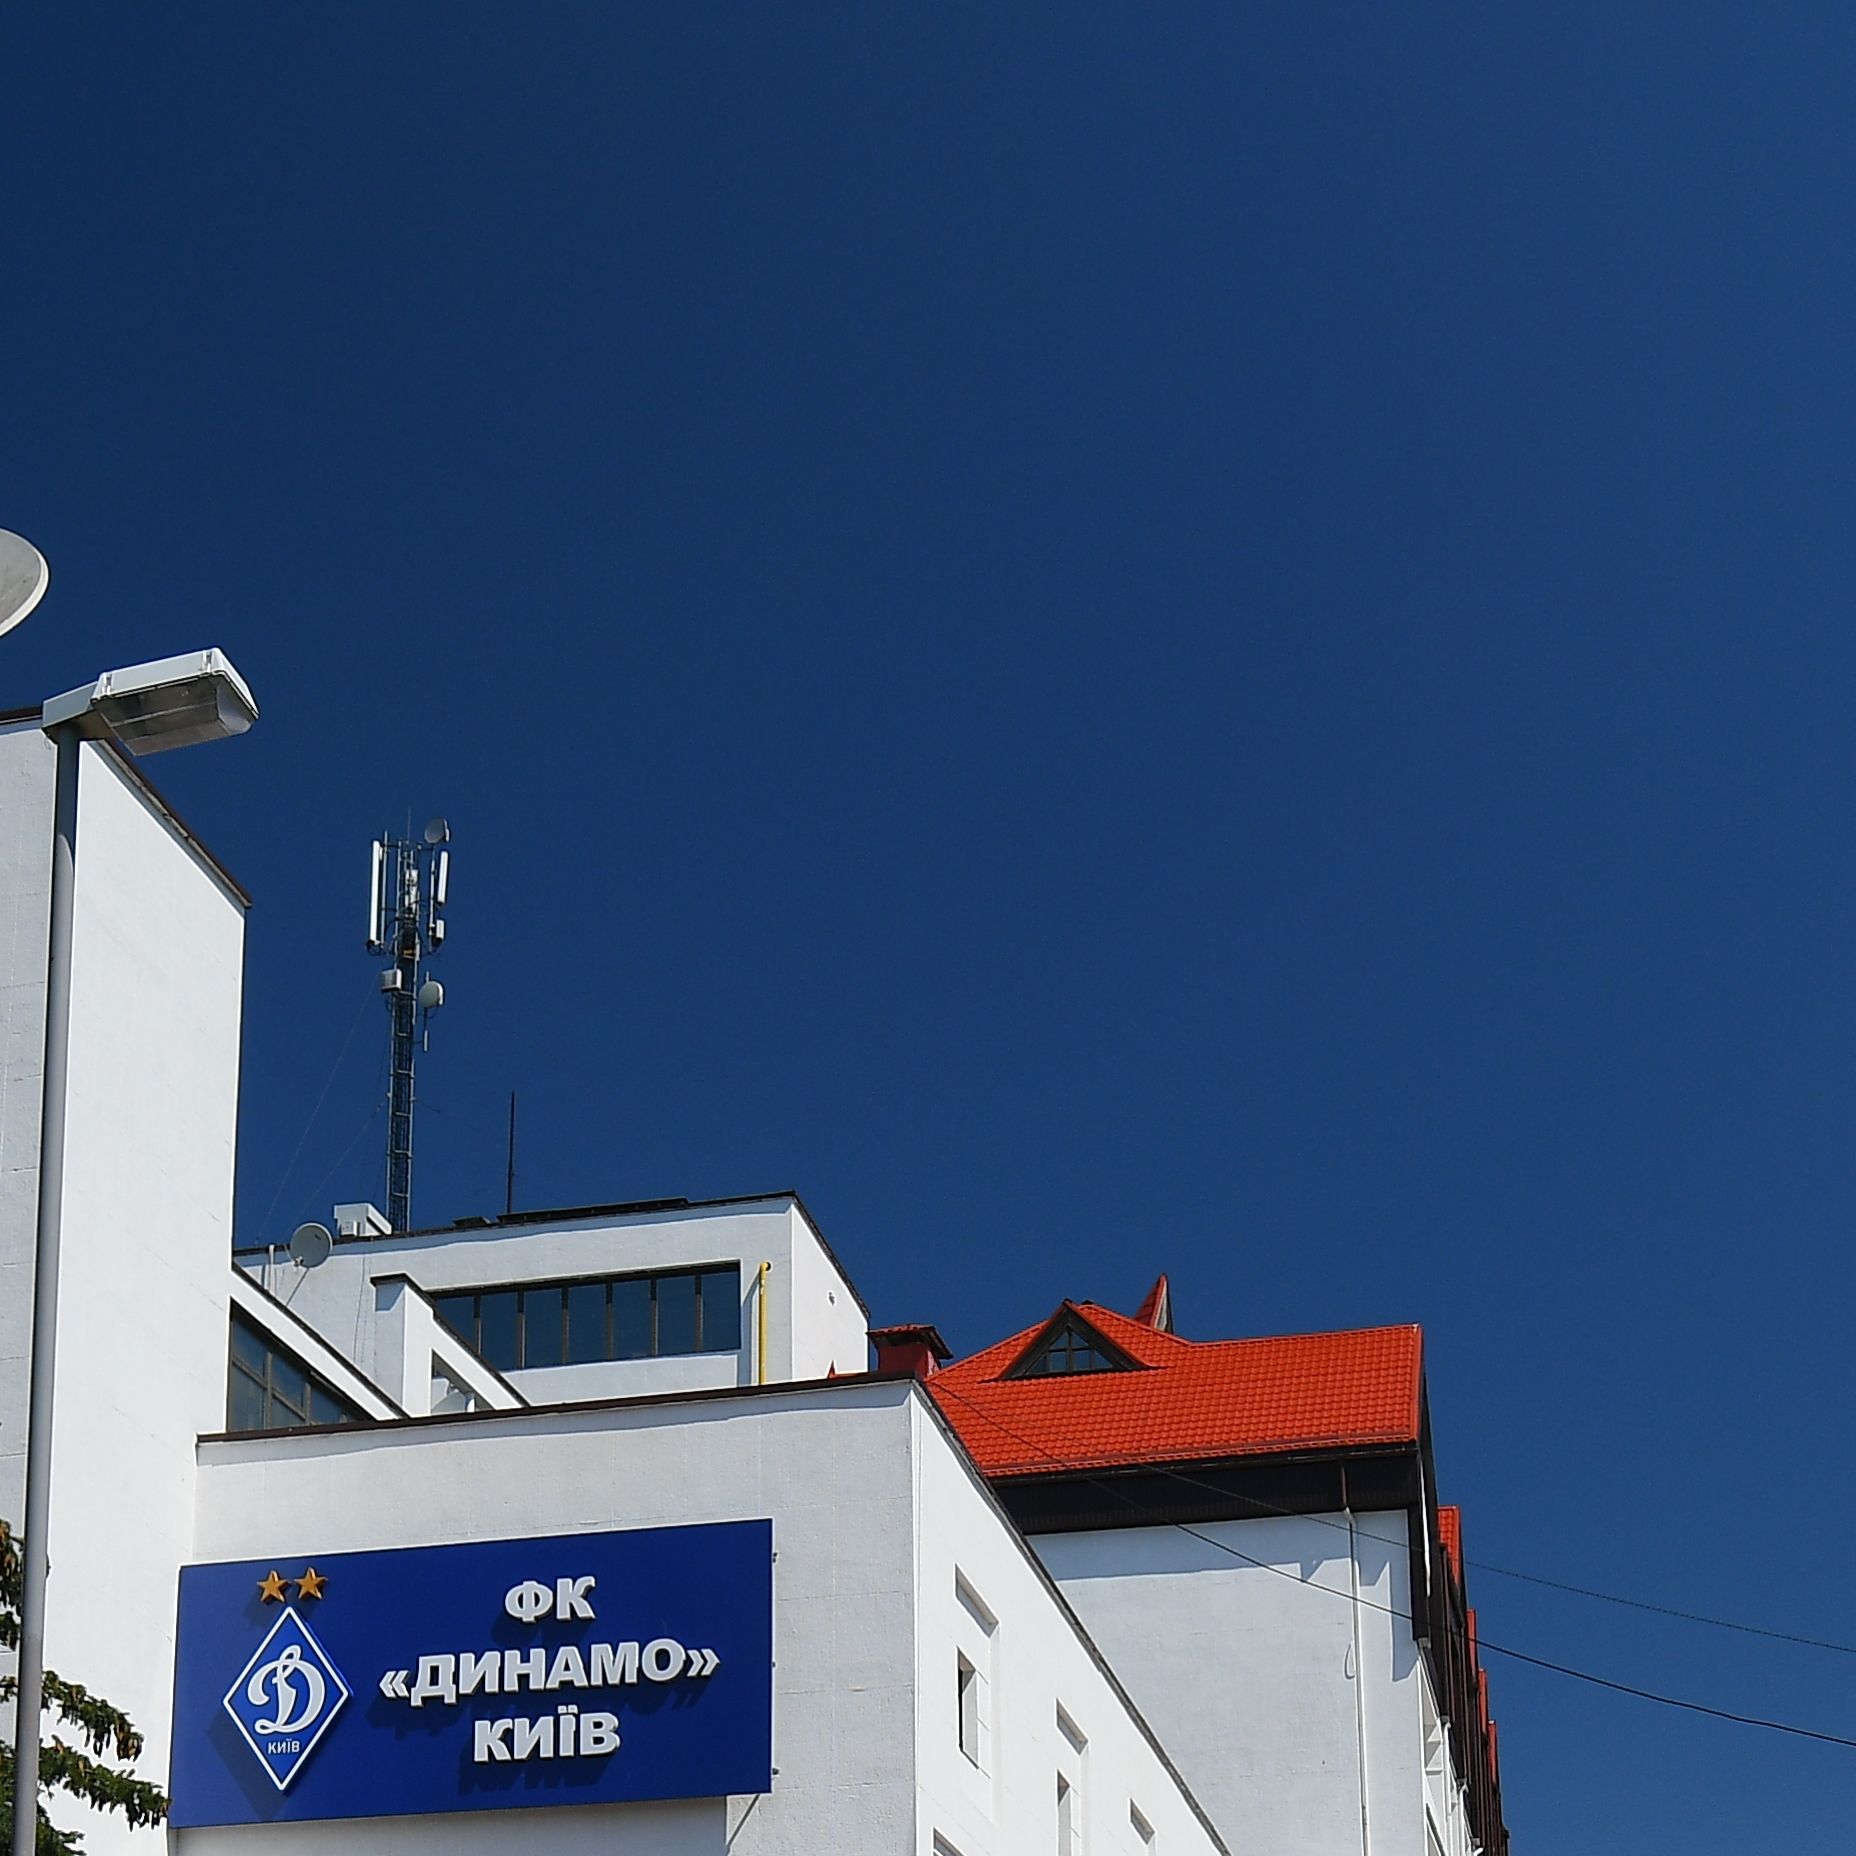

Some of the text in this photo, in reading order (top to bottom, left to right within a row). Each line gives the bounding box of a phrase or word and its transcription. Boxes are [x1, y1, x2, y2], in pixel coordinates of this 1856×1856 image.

[505, 1576, 596, 1622] ФК
[378, 1638, 720, 1706] «ДИНАМО»
[268, 1738, 301, 1754] КИЇВ
[473, 1705, 621, 1762] КИЇВ
